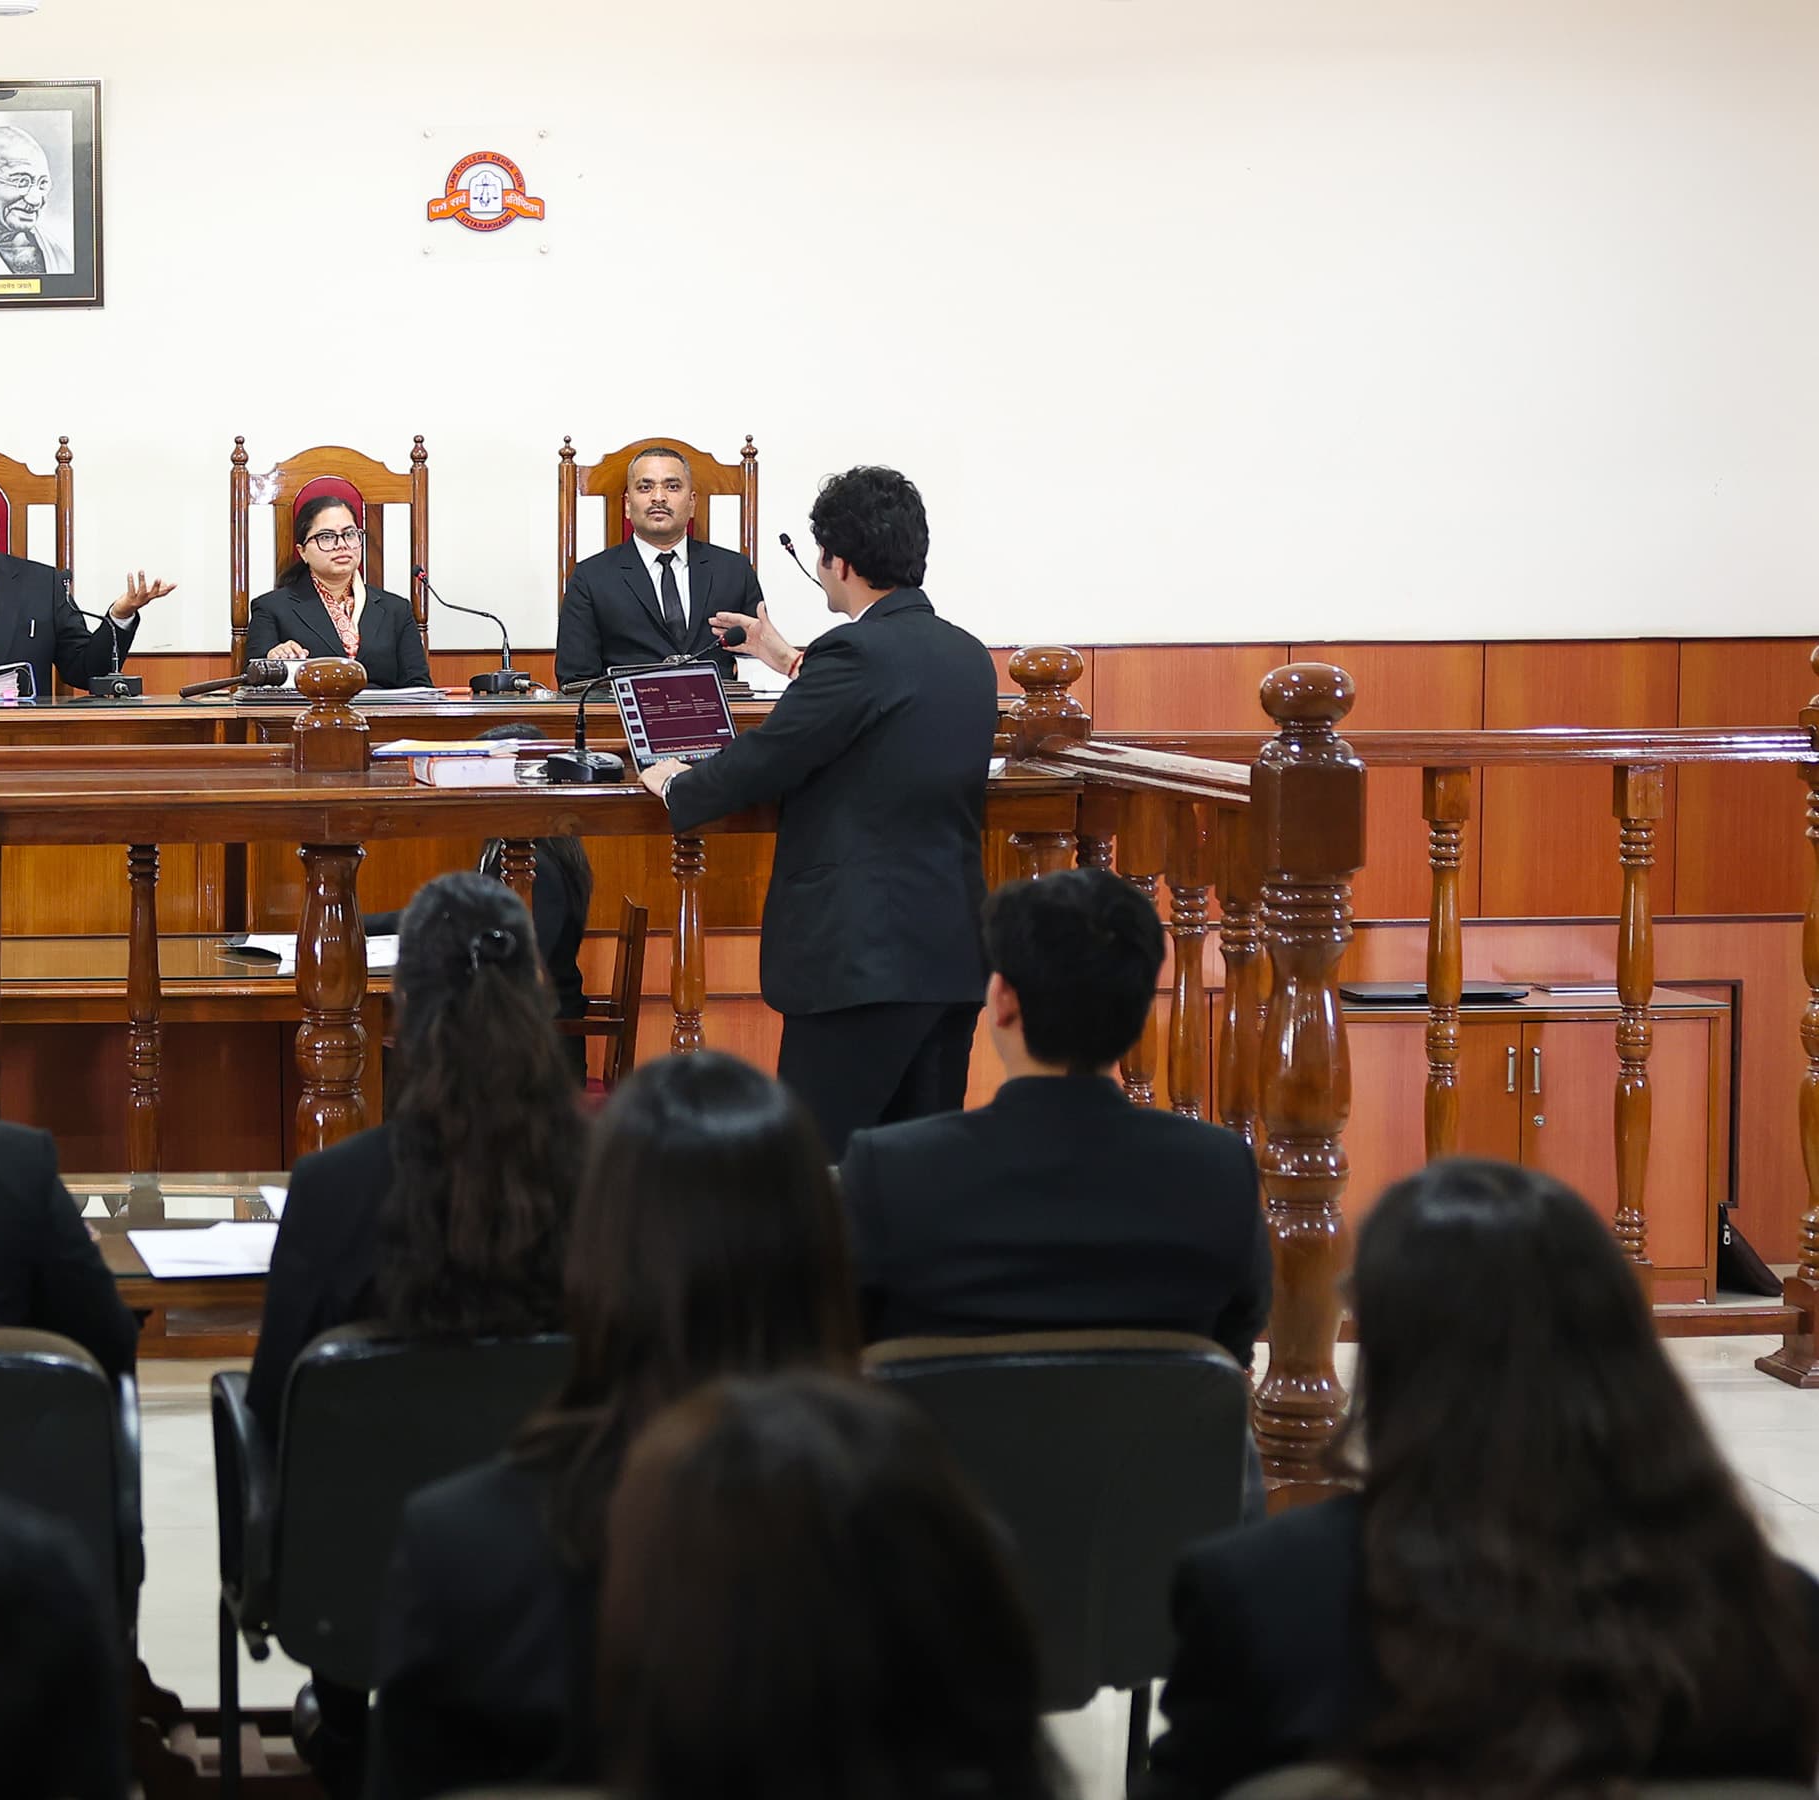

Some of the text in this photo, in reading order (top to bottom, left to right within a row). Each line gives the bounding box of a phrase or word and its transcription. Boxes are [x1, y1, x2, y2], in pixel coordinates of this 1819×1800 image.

[448, 173, 458, 189] LAW
[456, 154, 488, 173] COLLEGE
[460, 214, 512, 229] UTTARAKHAND
